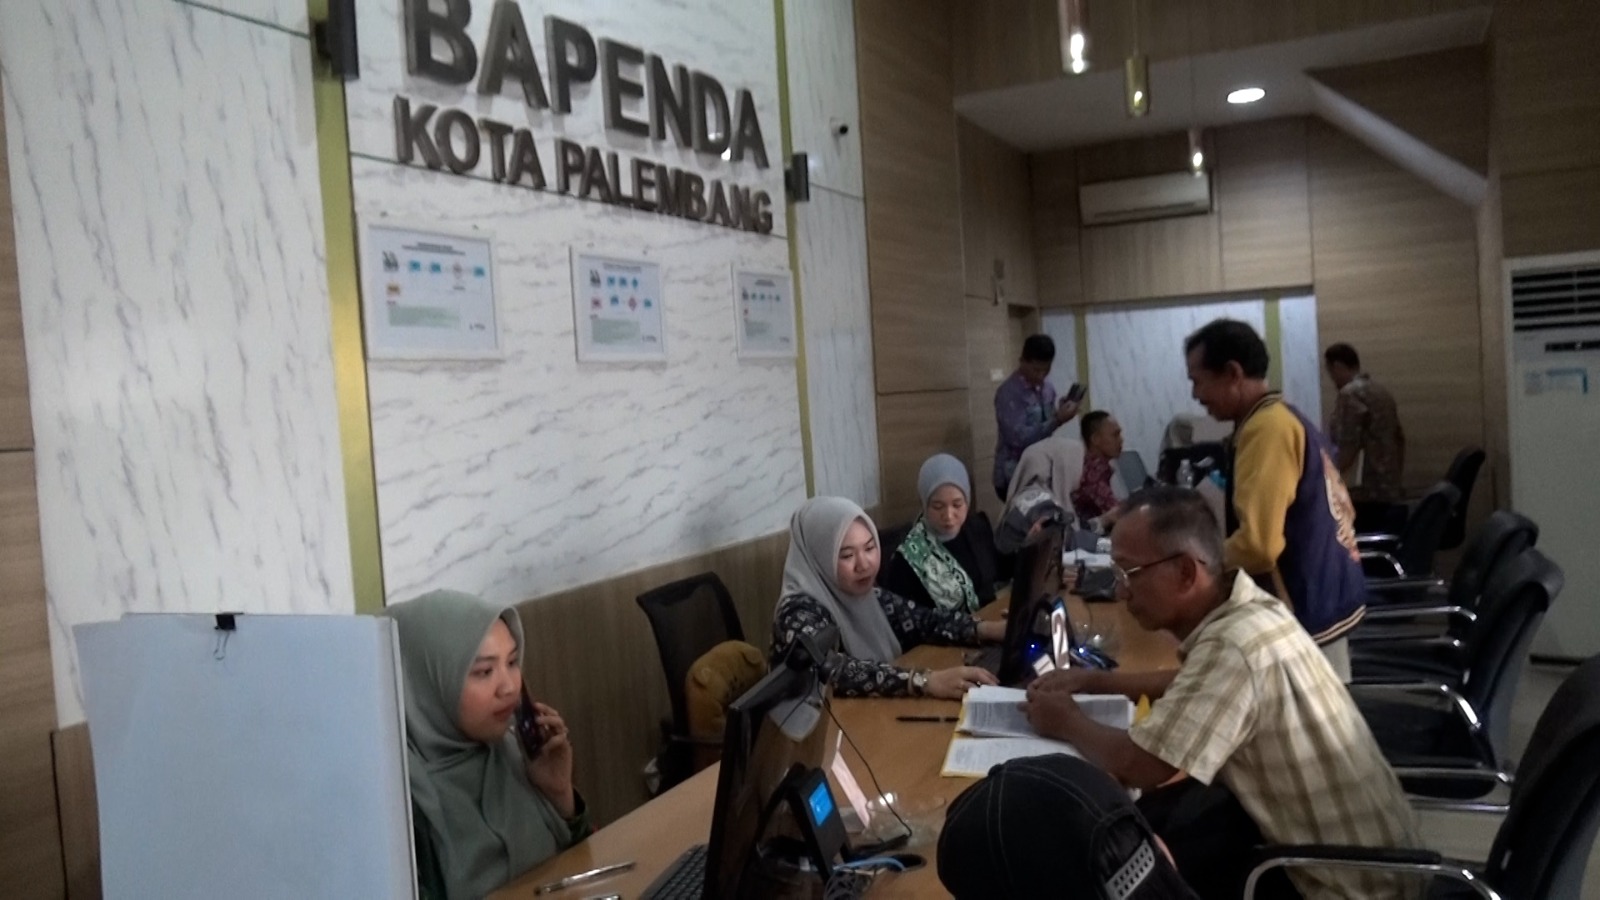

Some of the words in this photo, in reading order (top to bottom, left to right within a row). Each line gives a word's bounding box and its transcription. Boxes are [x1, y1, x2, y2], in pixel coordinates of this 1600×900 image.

[402, 0, 770, 169] BAPENDA
[393, 95, 547, 190] KOTA
[555, 138, 773, 235] PALEMBANG
